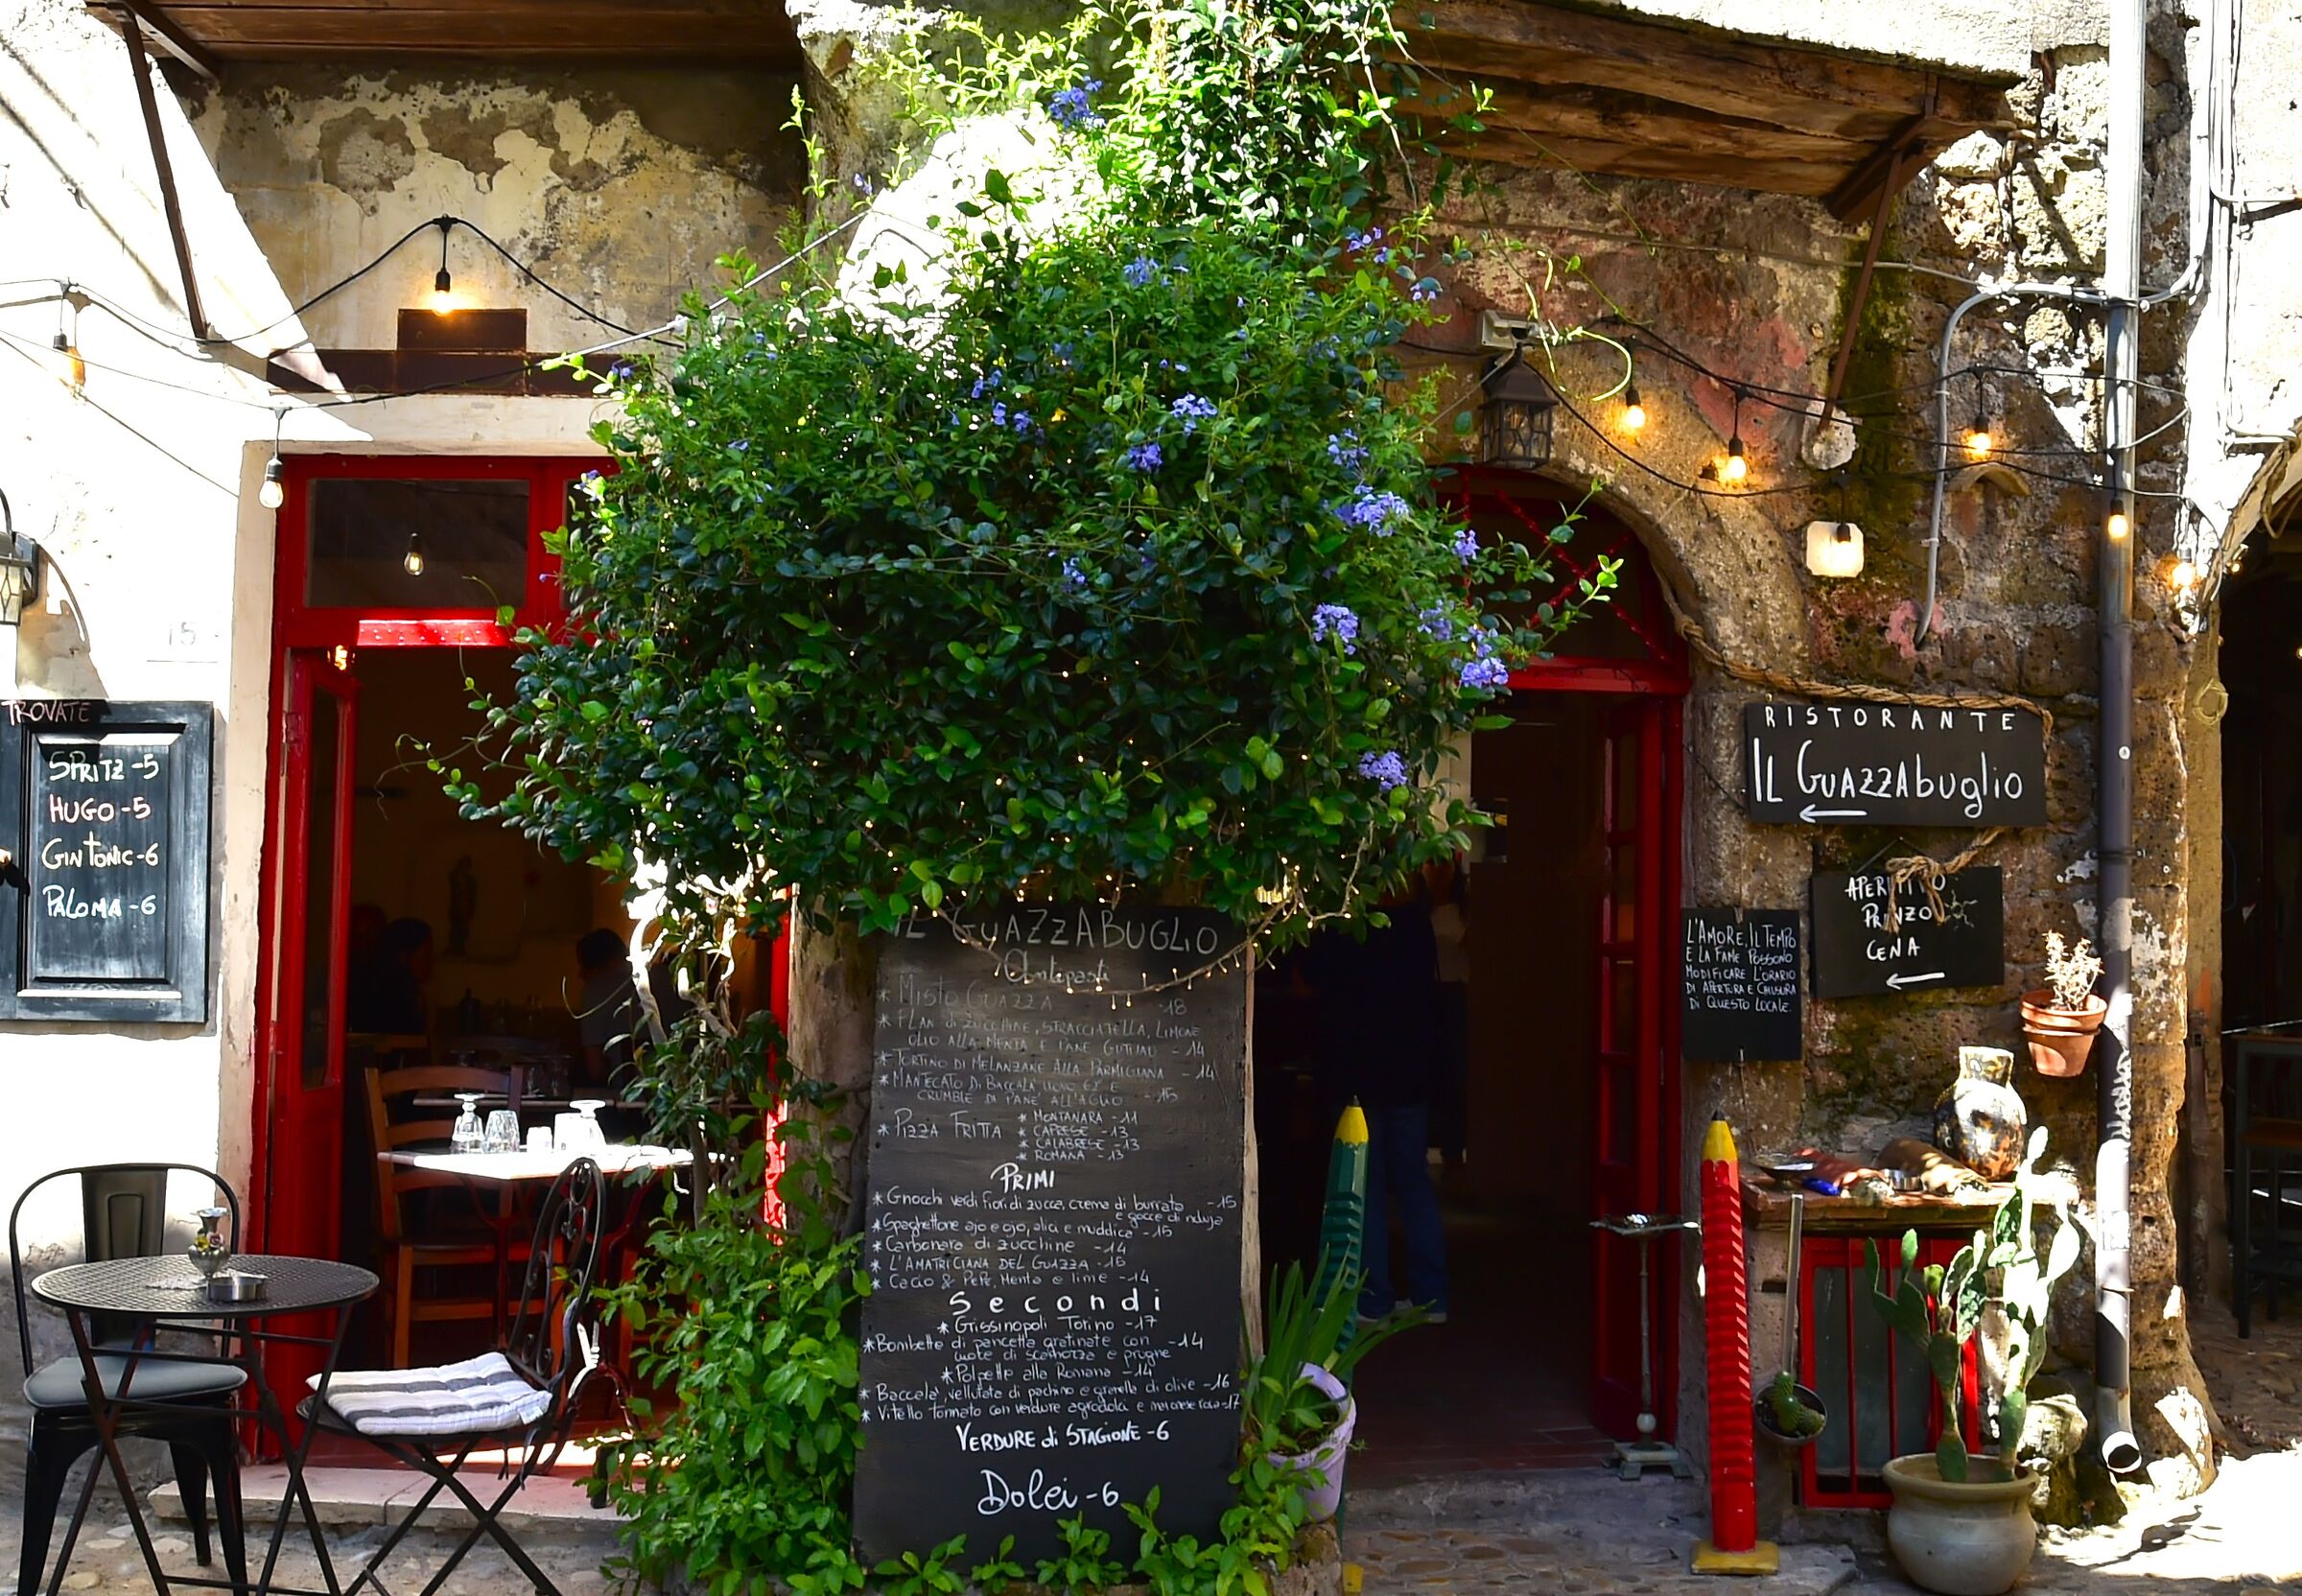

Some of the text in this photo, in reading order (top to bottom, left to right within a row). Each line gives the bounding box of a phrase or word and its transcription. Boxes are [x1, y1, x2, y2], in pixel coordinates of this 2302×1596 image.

[1, 700, 92, 726] TROVATE
[1765, 706, 2015, 732] RISTORANTE
[49, 751, 125, 783] SPRITZ
[1753, 738, 1782, 803] IL
[50, 794, 114, 823] HUGO
[42, 884, 123, 919] PALOMA
[1750, 922, 1761, 949] IL
[1761, 924, 1797, 949] TEMPO
[1686, 945, 1793, 966] E LA FAME POSSONO
[1867, 936, 1920, 961] CENA
[1685, 965, 1797, 981] MODIFICARE L'ORARIO
[1703, 980, 1745, 994] APERTURA
[1747, 984, 1753, 995] E
[1756, 981, 1797, 996] CHIUSURA
[1706, 996, 1750, 1010] QUESTO
[1033, 1110, 1103, 1125] MONTANARA
[990, 1162, 1055, 1193] PRIMI
[886, 1185, 943, 1206] Gnocchi
[951, 1190, 977, 1209] verdi
[1069, 1199, 1110, 1210] crema
[1115, 1196, 1126, 1210] di
[1133, 1193, 1185, 1211] burrata
[882, 1211, 959, 1237] Spaghettone
[991, 1221, 999, 1232] e
[1064, 1223, 1073, 1233] e
[1128, 1212, 1163, 1229] gocce
[885, 1234, 964, 1253] Carbonara
[975, 1235, 991, 1250] di
[997, 1236, 1075, 1253] zucchine
[998, 1253, 1024, 1270] DEL
[889, 1273, 934, 1289] Cacio
[1071, 1272, 1108, 1284] lime
[949, 1287, 1161, 1316] Secondi
[954, 1313, 1047, 1338] Grissinopoli
[1056, 1314, 1116, 1331] Torino
[951, 1335, 966, 1350] di
[1122, 1335, 1150, 1348] con
[1022, 1363, 1048, 1381] alla
[1008, 1385, 1022, 1399] di
[1145, 1379, 1160, 1394] di
[1164, 1376, 1196, 1392] olive
[877, 1401, 924, 1421] Vitello
[955, 1421, 1036, 1452] VERDURE
[1041, 1425, 1059, 1448] di
